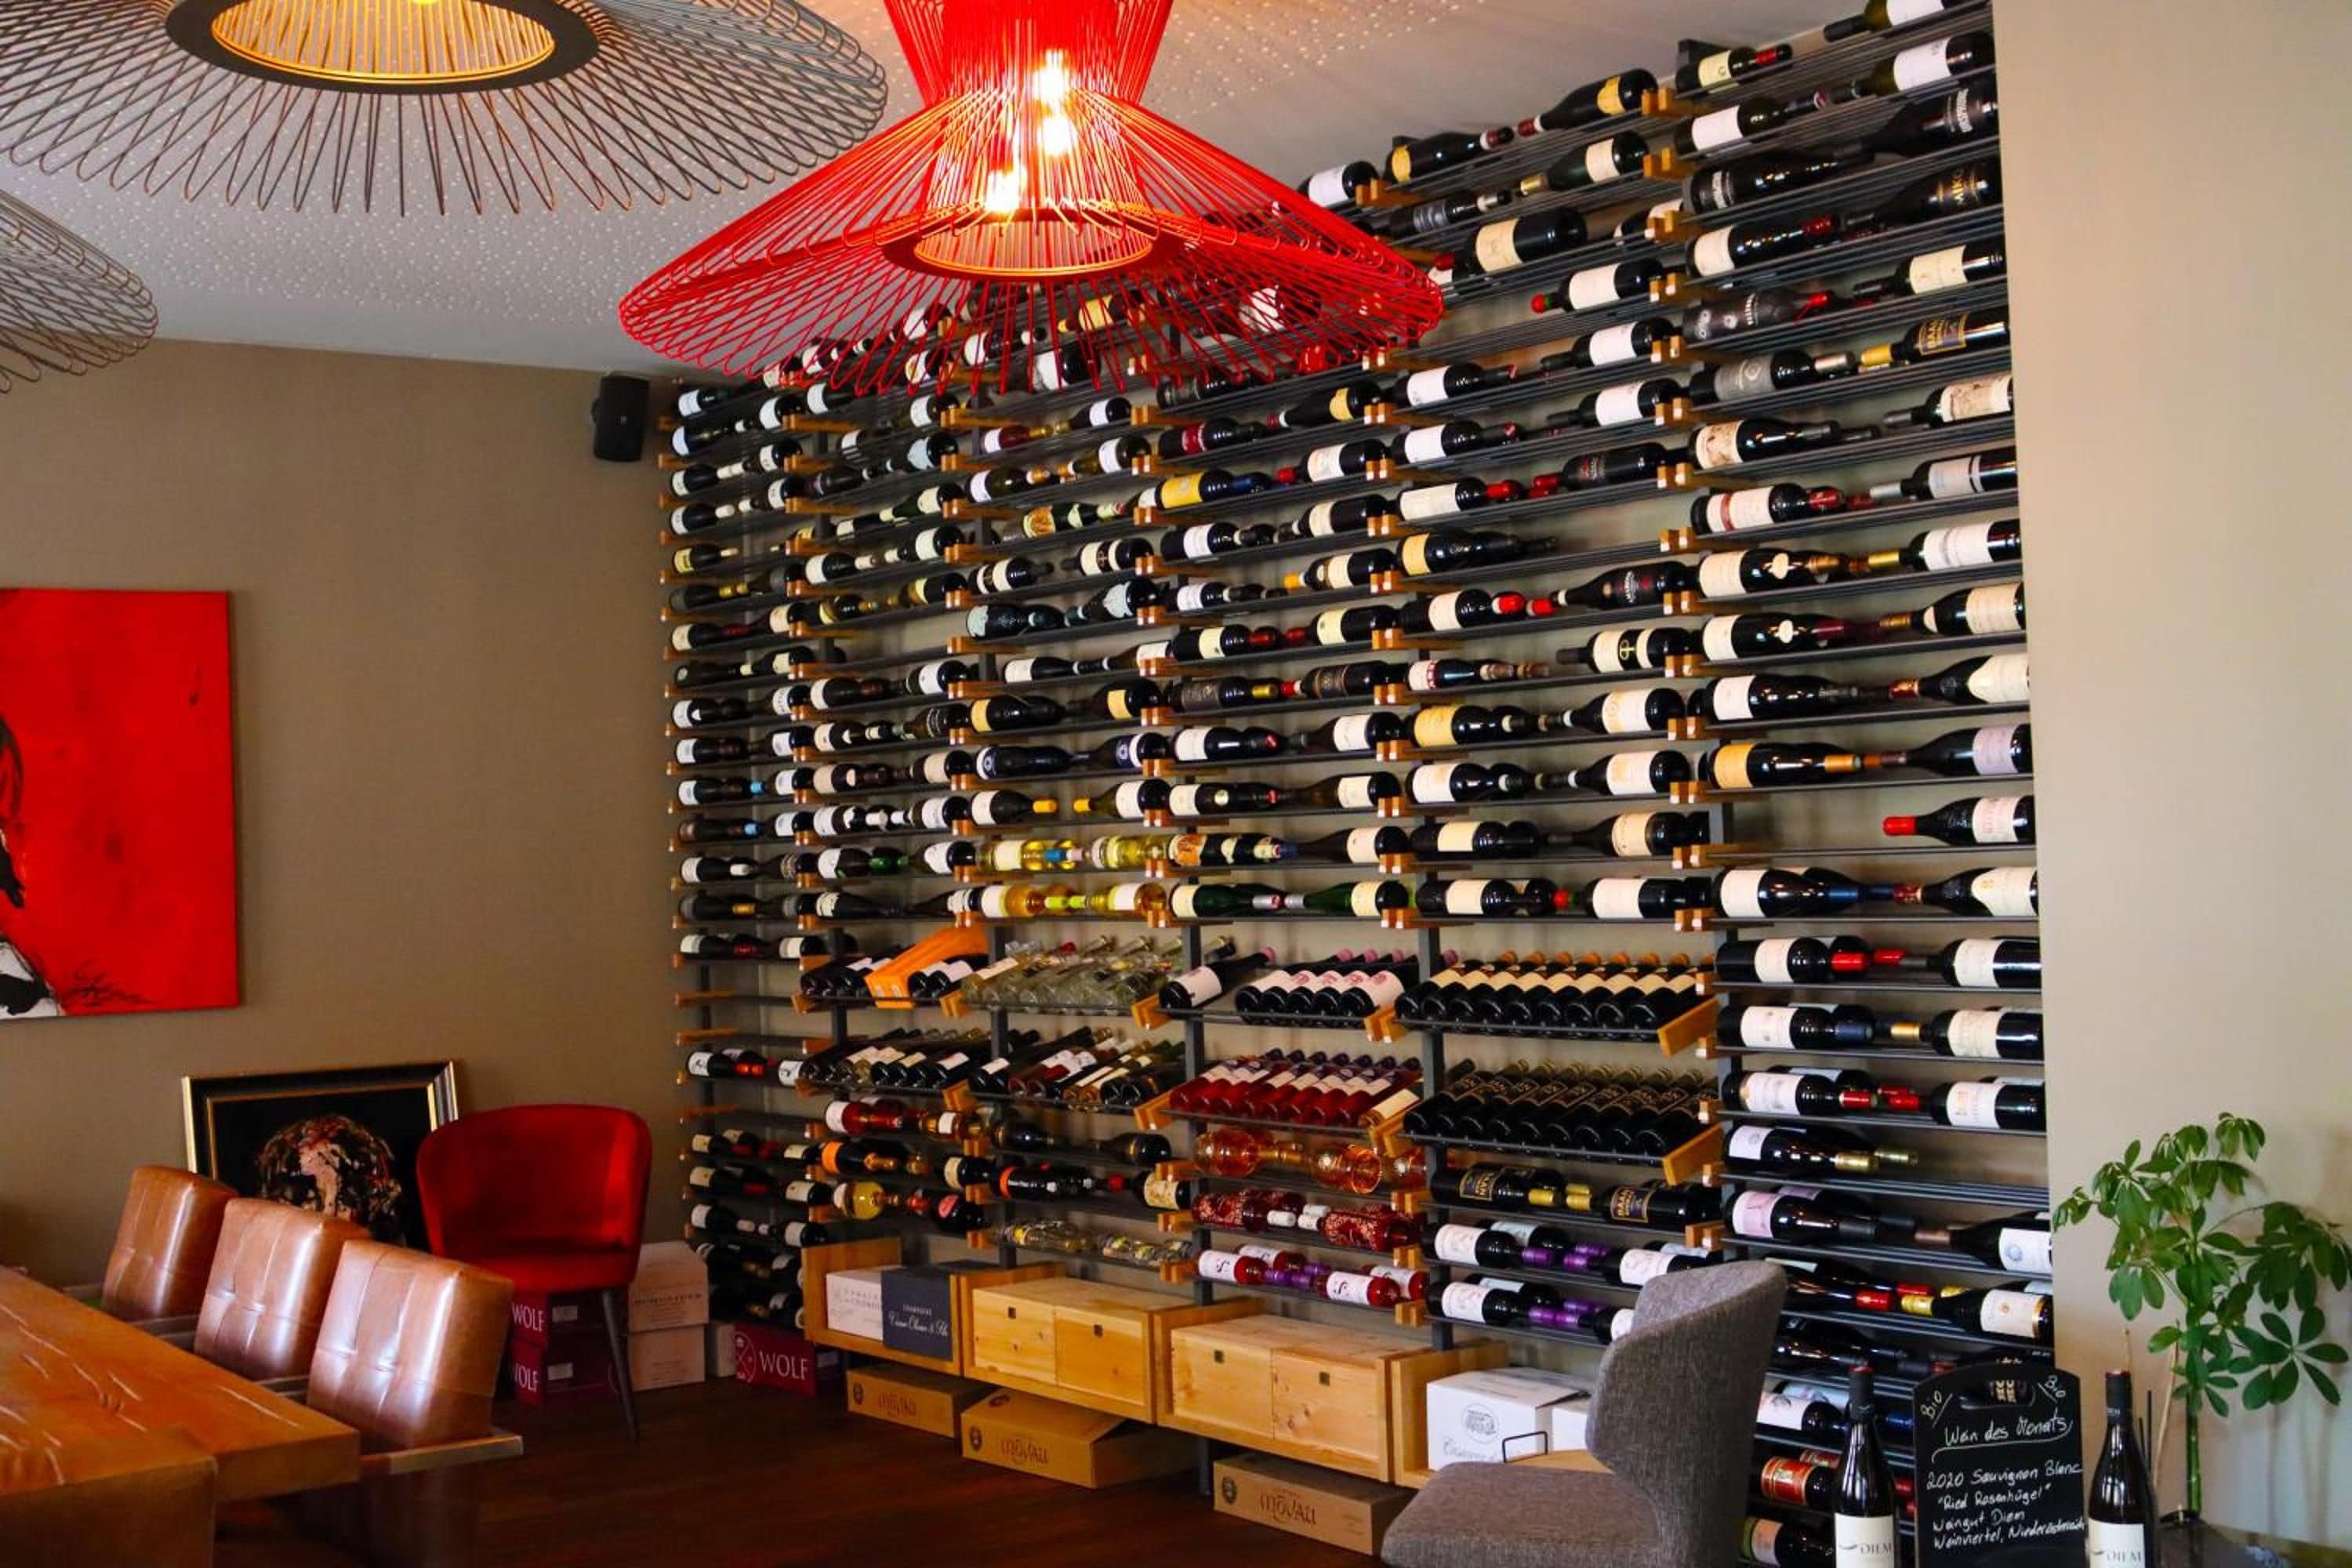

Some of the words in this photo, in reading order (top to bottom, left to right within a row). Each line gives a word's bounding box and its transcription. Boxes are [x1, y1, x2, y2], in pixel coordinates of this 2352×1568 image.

[512, 1302, 545, 1332] WOLF
[759, 1350, 809, 1381] WOLF
[1984, 1420, 2009, 1441] des
[1926, 1471, 1965, 1490] 2020
[1970, 1468, 2039, 1486] Sauvignon
